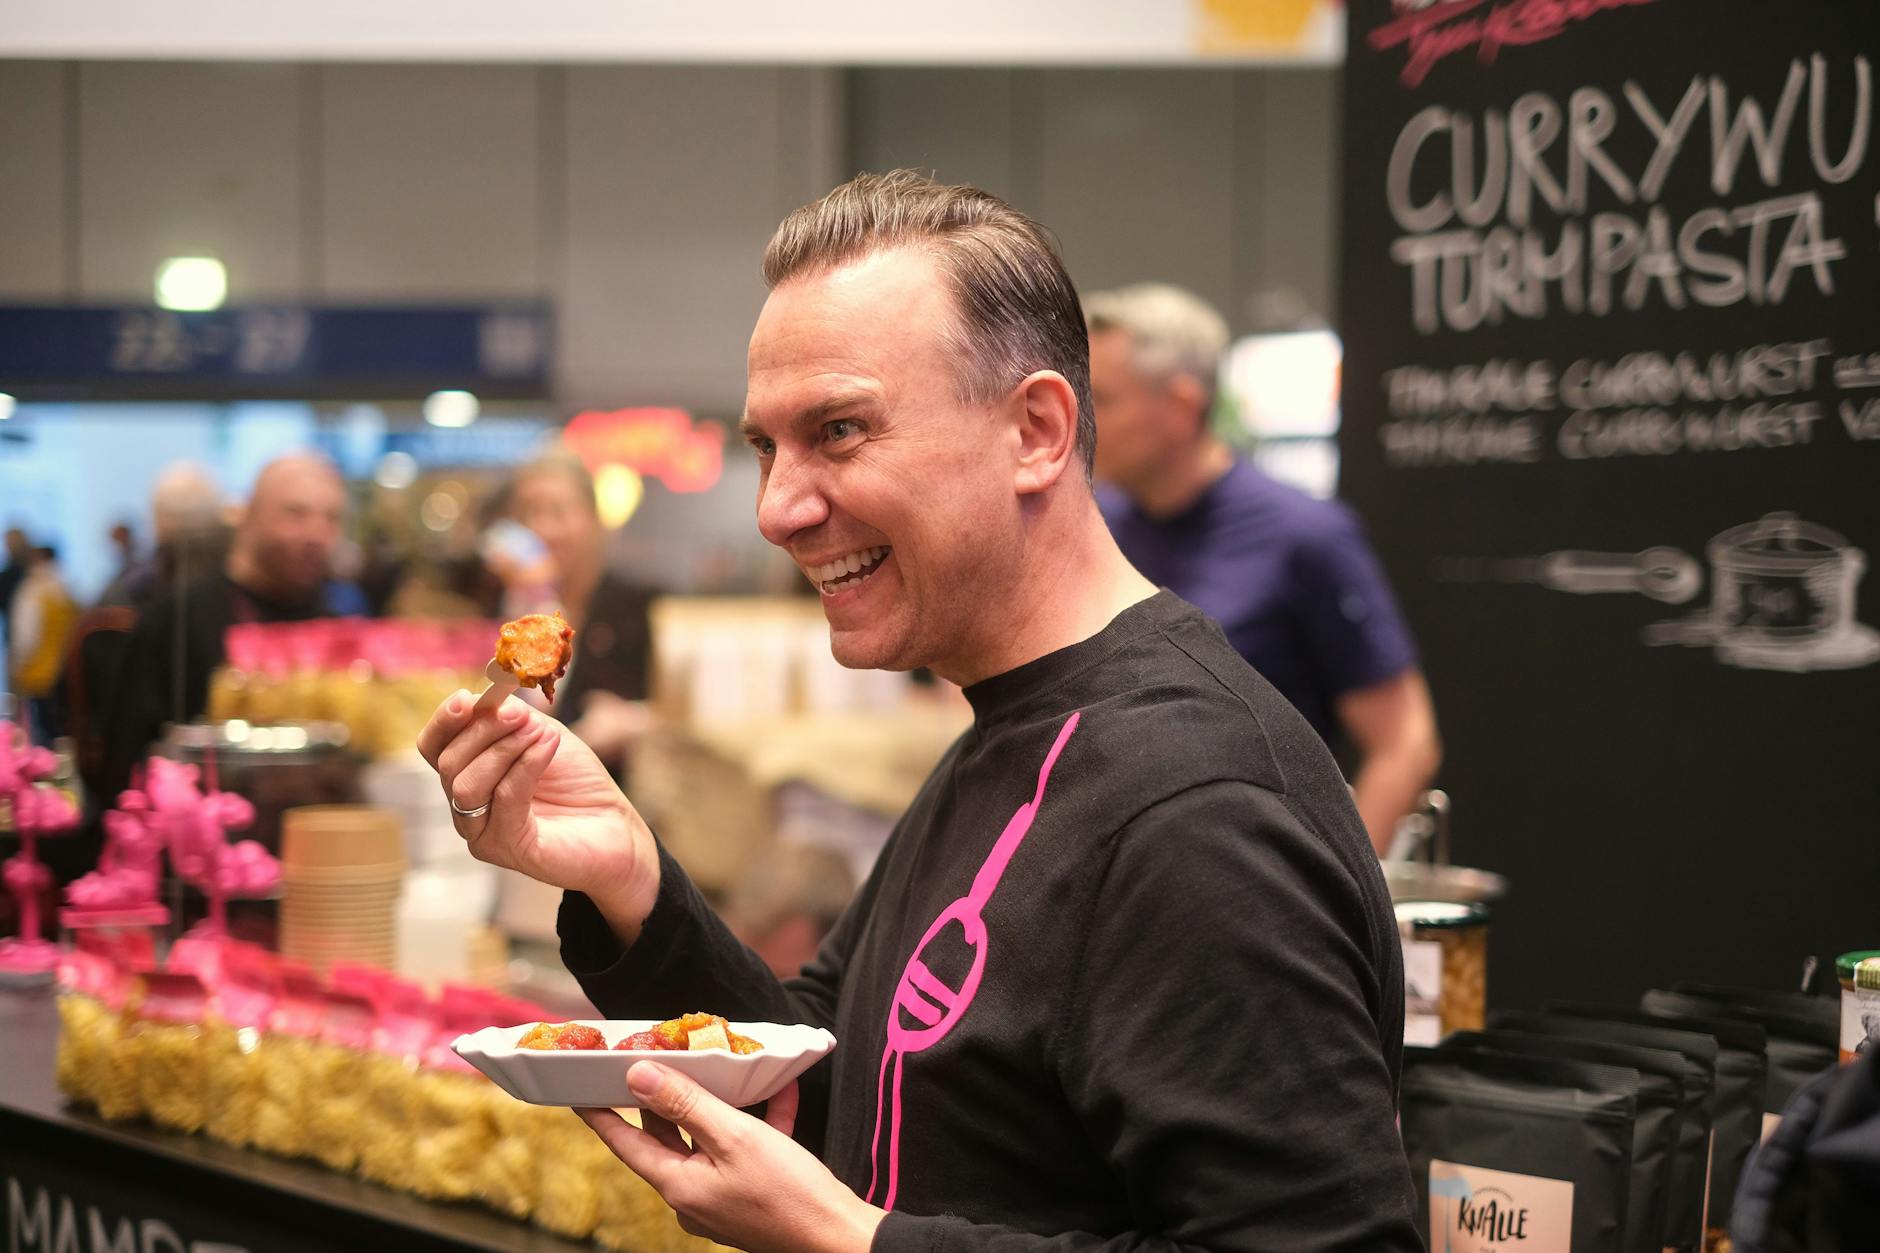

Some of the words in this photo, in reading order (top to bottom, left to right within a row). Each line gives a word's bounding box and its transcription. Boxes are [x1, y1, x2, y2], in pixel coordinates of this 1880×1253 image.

[1386, 52, 1871, 231] CURRYWU
[1390, 191, 1847, 334] TURMPASTA
[1458, 1195, 1529, 1242] KNALLE
